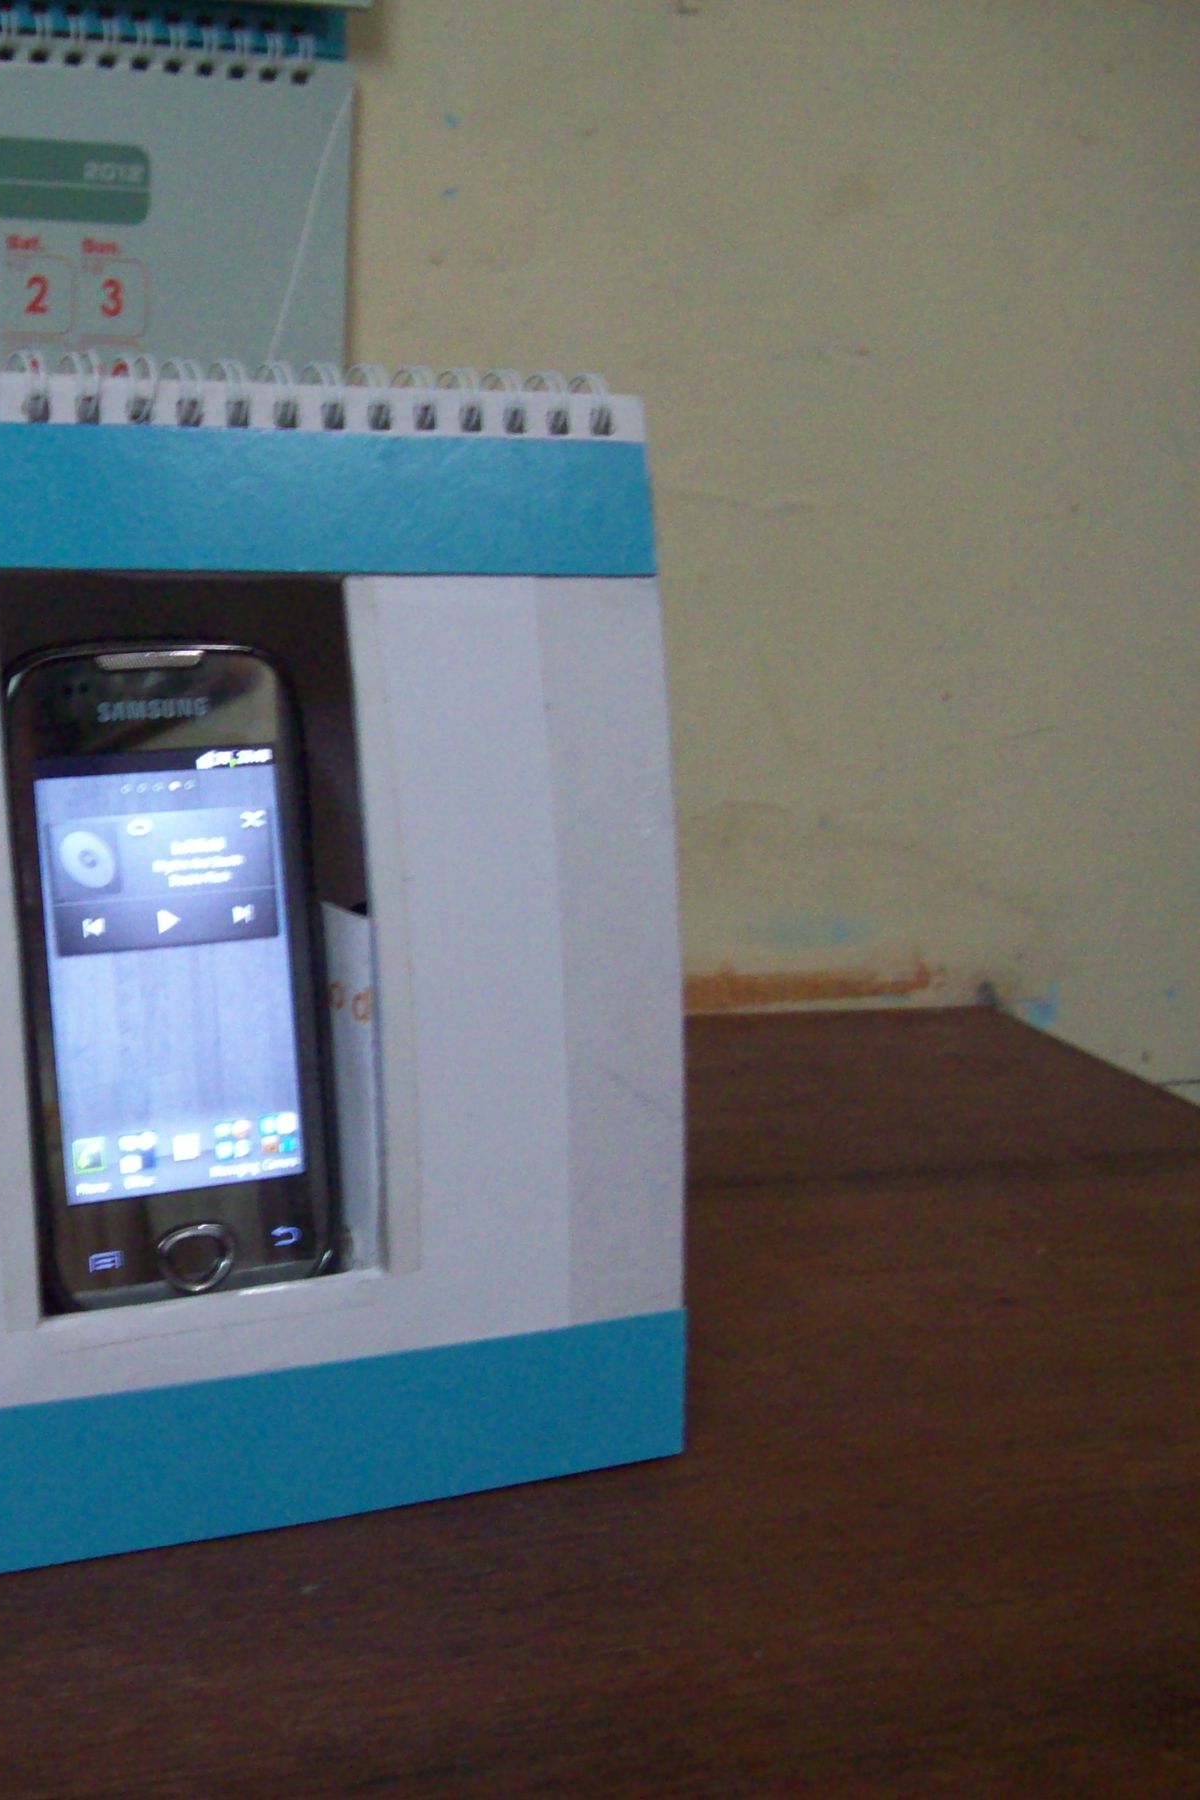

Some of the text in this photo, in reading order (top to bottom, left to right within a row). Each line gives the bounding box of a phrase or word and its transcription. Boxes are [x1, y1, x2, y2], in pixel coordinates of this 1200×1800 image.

[25, 276, 49, 315] 2
[100, 279, 124, 317] 3
[97, 697, 209, 722] SAMSUNG
